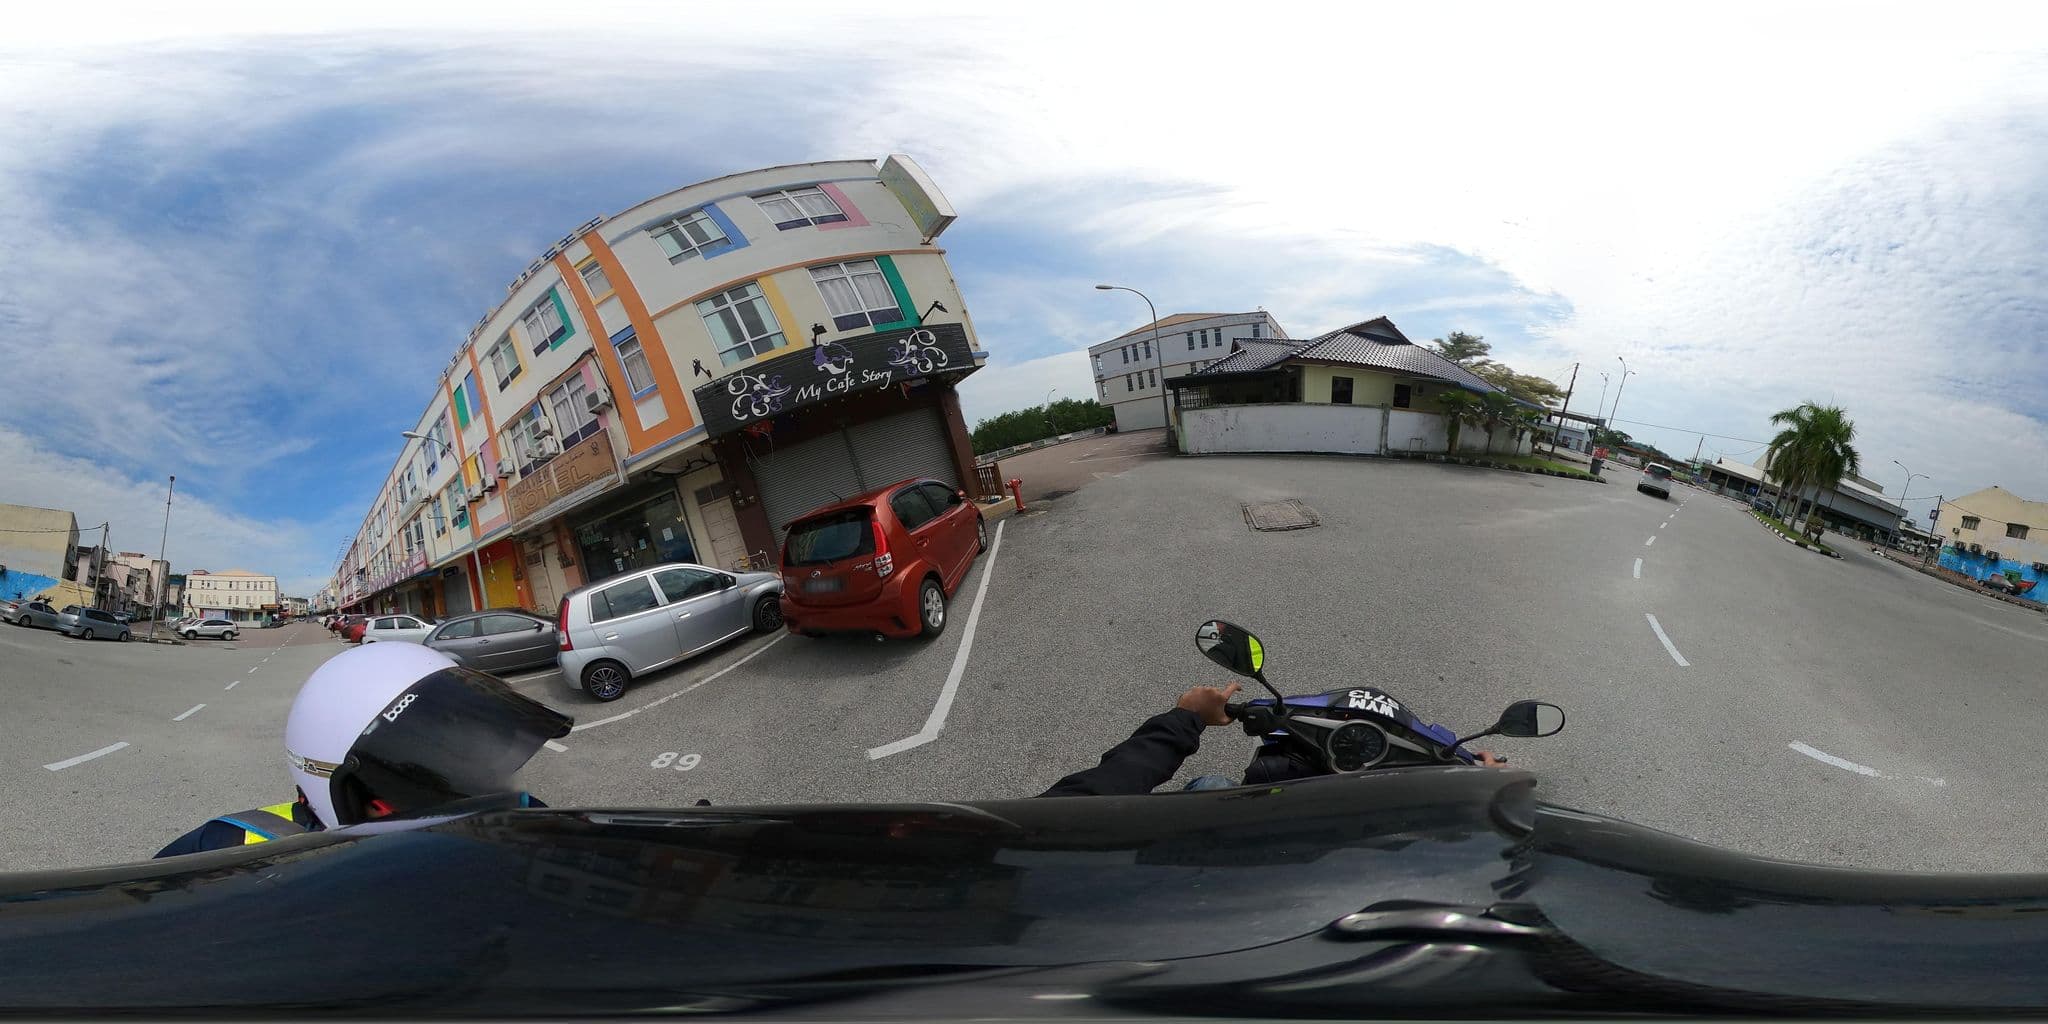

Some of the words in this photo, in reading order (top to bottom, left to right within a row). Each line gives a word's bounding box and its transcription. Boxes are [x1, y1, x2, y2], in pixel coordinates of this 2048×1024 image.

[795, 384, 821, 402] My
[827, 371, 855, 393] Cafe
[862, 369, 892, 390] Story
[510, 466, 591, 518] HOTEL
[1349, 697, 1394, 718] WYM
[650, 751, 701, 771] 89
